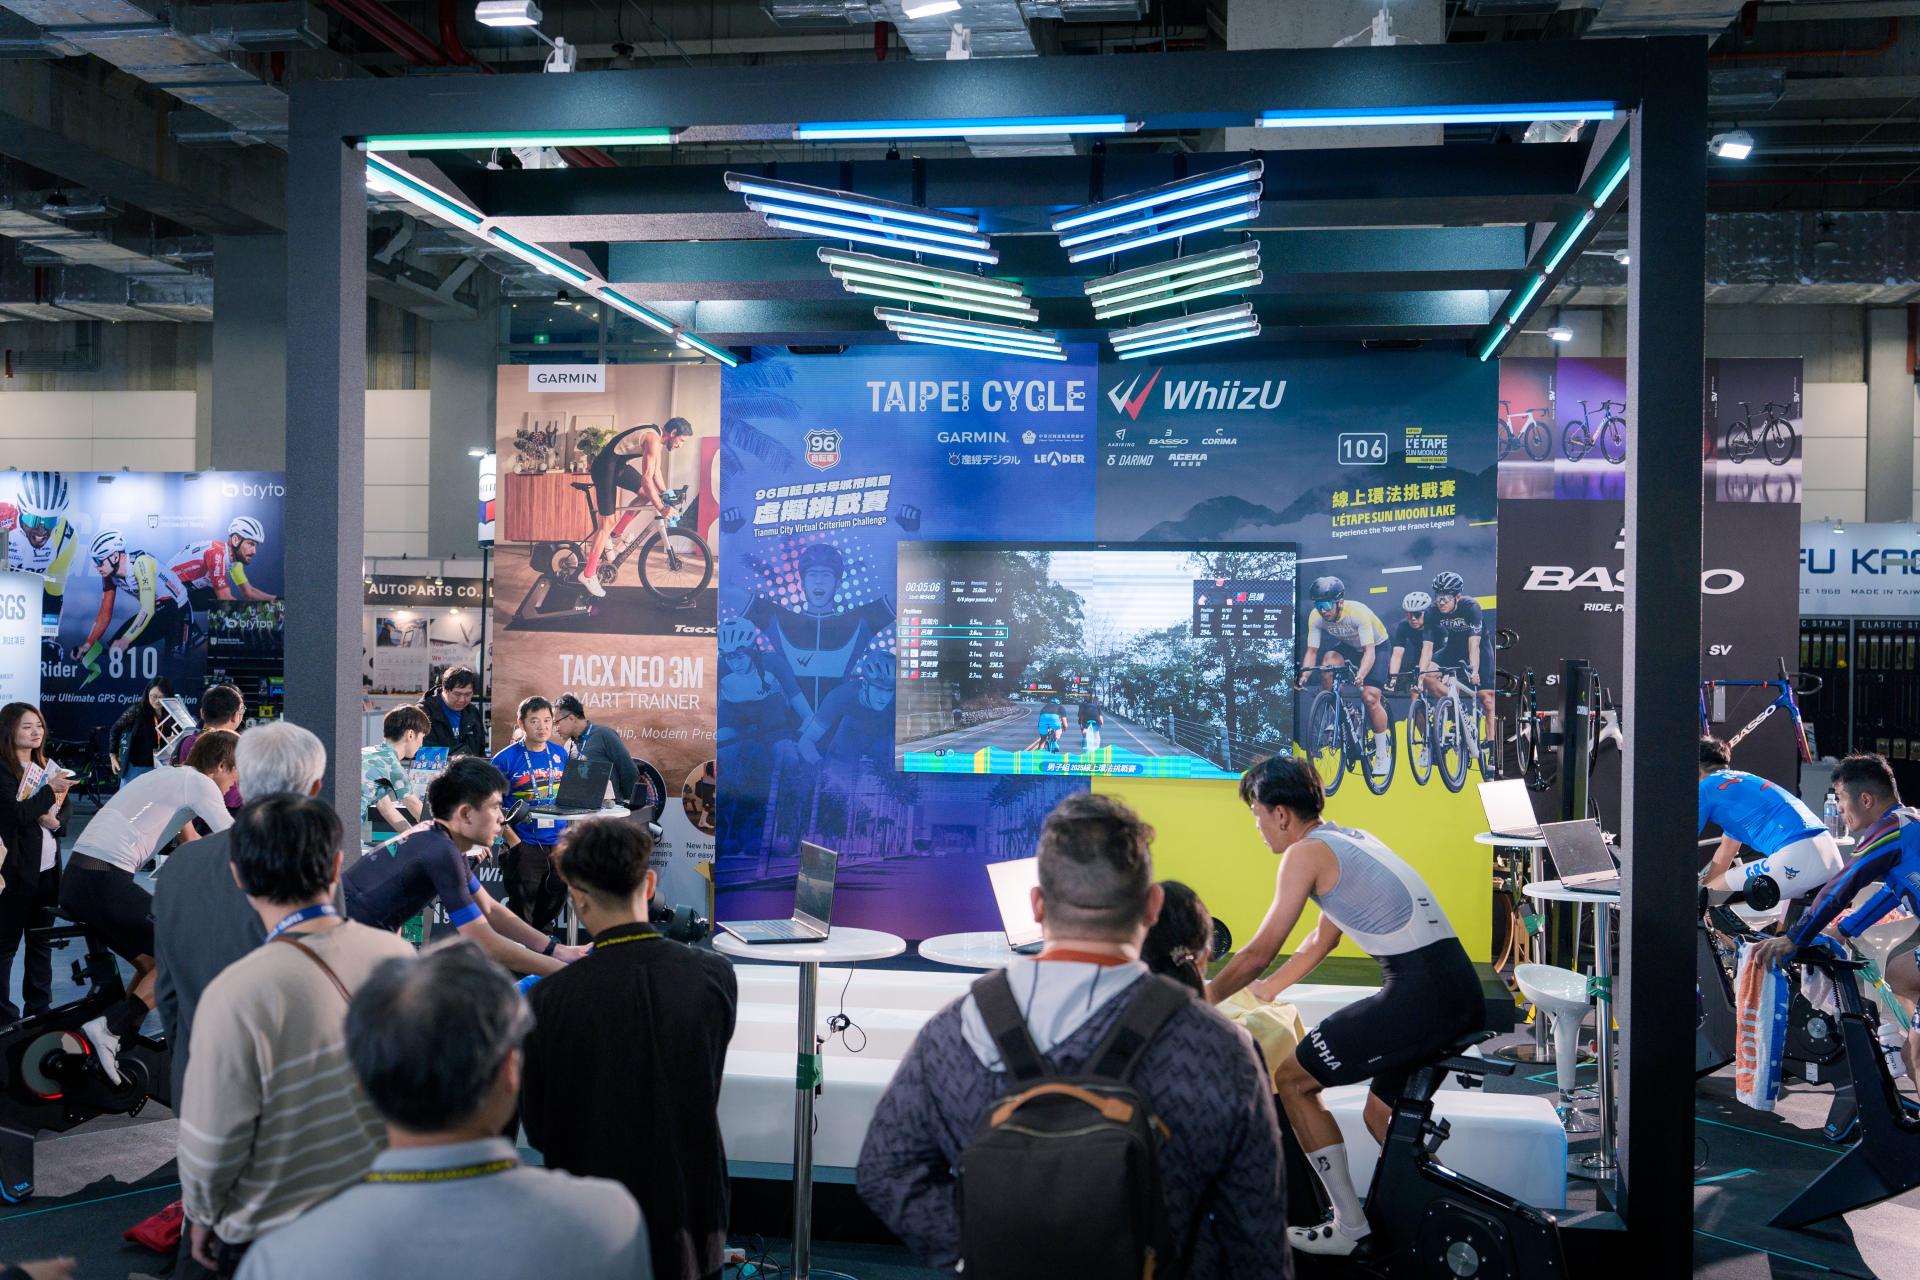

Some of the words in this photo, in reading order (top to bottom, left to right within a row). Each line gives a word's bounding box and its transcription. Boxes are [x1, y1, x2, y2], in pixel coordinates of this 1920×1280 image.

[537, 373, 598, 384] GARMIN
[866, 380, 970, 412] TAIPEI
[982, 380, 1085, 412] CYCLE
[1163, 380, 1287, 410] WhiizU
[811, 436, 835, 452] 96
[937, 431, 1008, 443] GARMIN
[1201, 438, 1238, 446] CORIMA
[1343, 439, 1383, 459] 106
[1034, 451, 1085, 466] LEADER
[1118, 454, 1154, 466] DARIMO
[242, 482, 287, 499] bryto
[1332, 480, 1456, 509] 線上環法挑戰賽
[1371, 510, 1393, 523] SUN
[1394, 507, 1429, 521] MOON
[1430, 504, 1456, 518] LAKE
[754, 528, 779, 537] Tianmu
[779, 526, 794, 536] City
[795, 523, 818, 533] Virtual
[819, 520, 851, 531] Criterium
[852, 516, 887, 528] Challenge
[1332, 528, 1368, 539] Experience
[1407, 521, 1429, 531] France
[1430, 519, 1455, 530] Legend
[368, 583, 453, 597] AUTOPARTS
[905, 582, 941, 592] 00:05:06
[1583, 603, 1613, 613] RIDE,
[674, 624, 717, 634] Tacx
[1862, 621, 1902, 629] ELASTIC
[1709, 644, 1732, 656] SV
[108, 646, 158, 679] 810
[559, 654, 617, 687] TACX
[620, 655, 665, 688] NEO
[669, 655, 704, 689] 3M
[58, 693, 96, 703] Ultimate
[98, 694, 116, 703] GPS
[629, 692, 701, 710] TRAINER
[641, 727, 688, 740] Modern
[697, 852, 714, 860] easy
